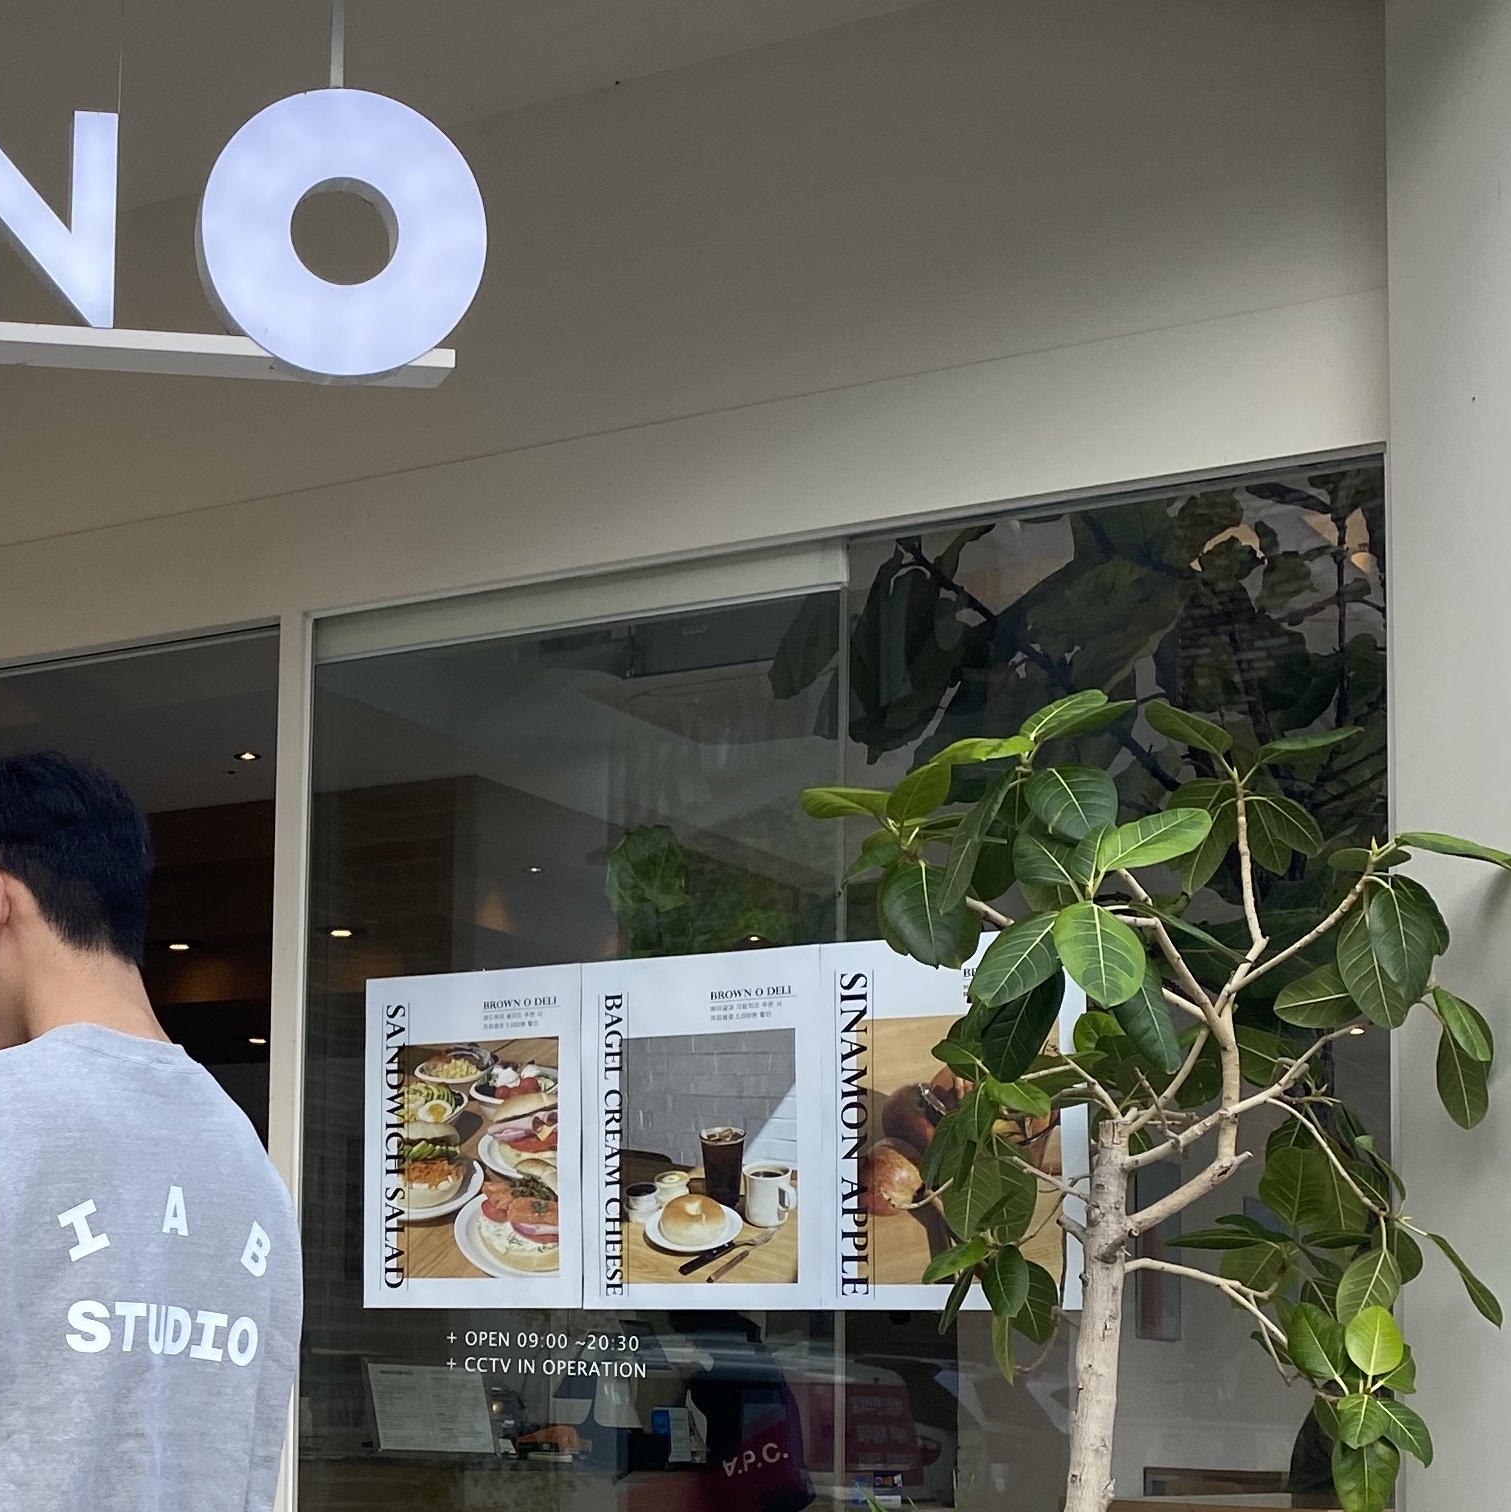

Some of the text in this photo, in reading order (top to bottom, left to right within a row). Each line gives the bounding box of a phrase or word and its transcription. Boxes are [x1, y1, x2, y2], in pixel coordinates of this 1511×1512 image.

[198, 87, 487, 376] O
[483, 996, 557, 1010] BROWN O DELI
[710, 985, 792, 1000] BROWN O DELI
[384, 1004, 406, 1289] SANDWICH SALAD
[604, 994, 624, 1297] BAGEL CREAM CHEESE
[839, 972, 869, 1297] SINAMON APPLE
[65, 1300, 258, 1367] STUDIO
[464, 1356, 511, 1373] CCTV
[518, 1358, 535, 1374] IN
[542, 1359, 646, 1378] OPERATION
[465, 1331, 510, 1347] OPEN
[517, 1332, 568, 1349] 09:00
